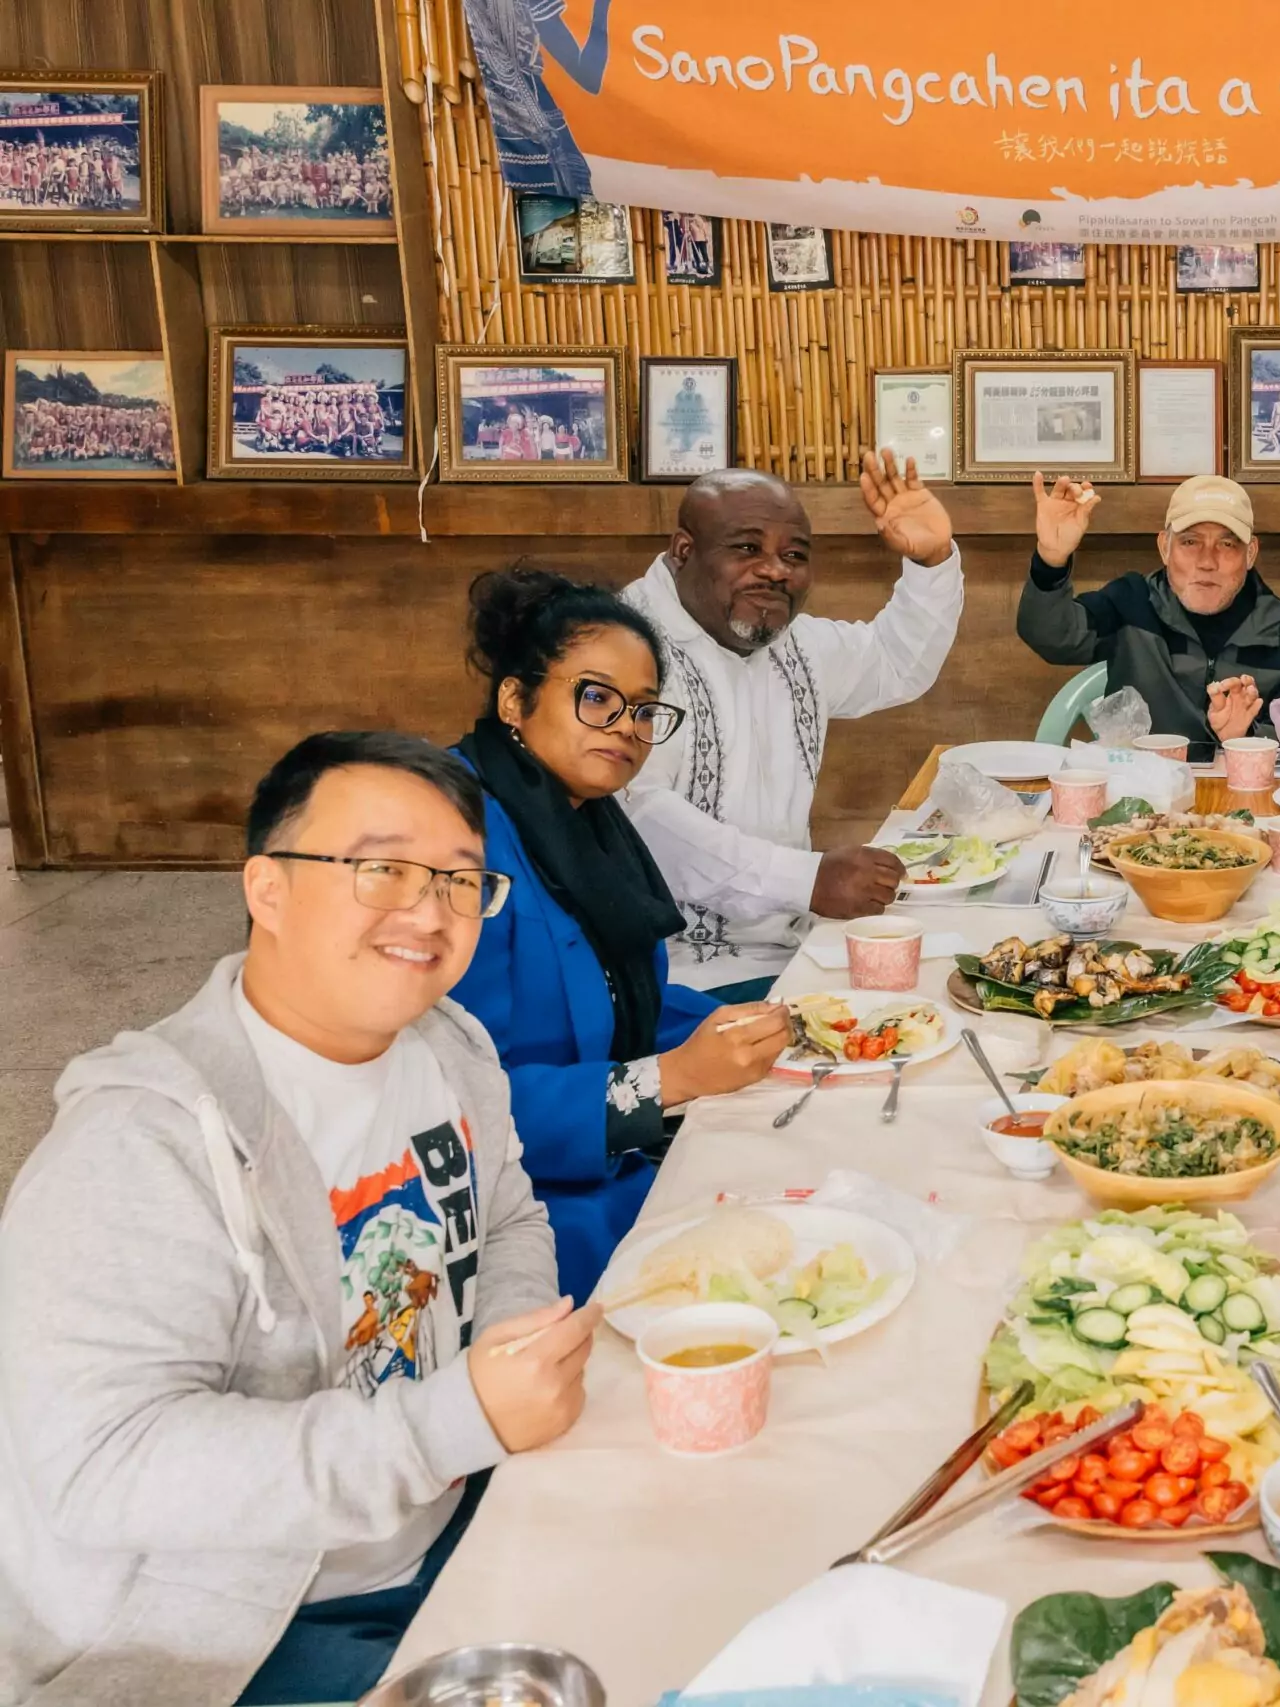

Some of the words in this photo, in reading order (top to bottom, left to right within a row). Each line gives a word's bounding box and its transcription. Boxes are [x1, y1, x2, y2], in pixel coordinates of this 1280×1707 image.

[1108, 56, 1200, 120] ita
[1218, 77, 1262, 117] a
[994, 128, 1229, 167] 讓我們一起說族語
[1160, 215, 1172, 226] to
[1174, 215, 1208, 226] Sowal
[1229, 214, 1278, 227] Pangcah
